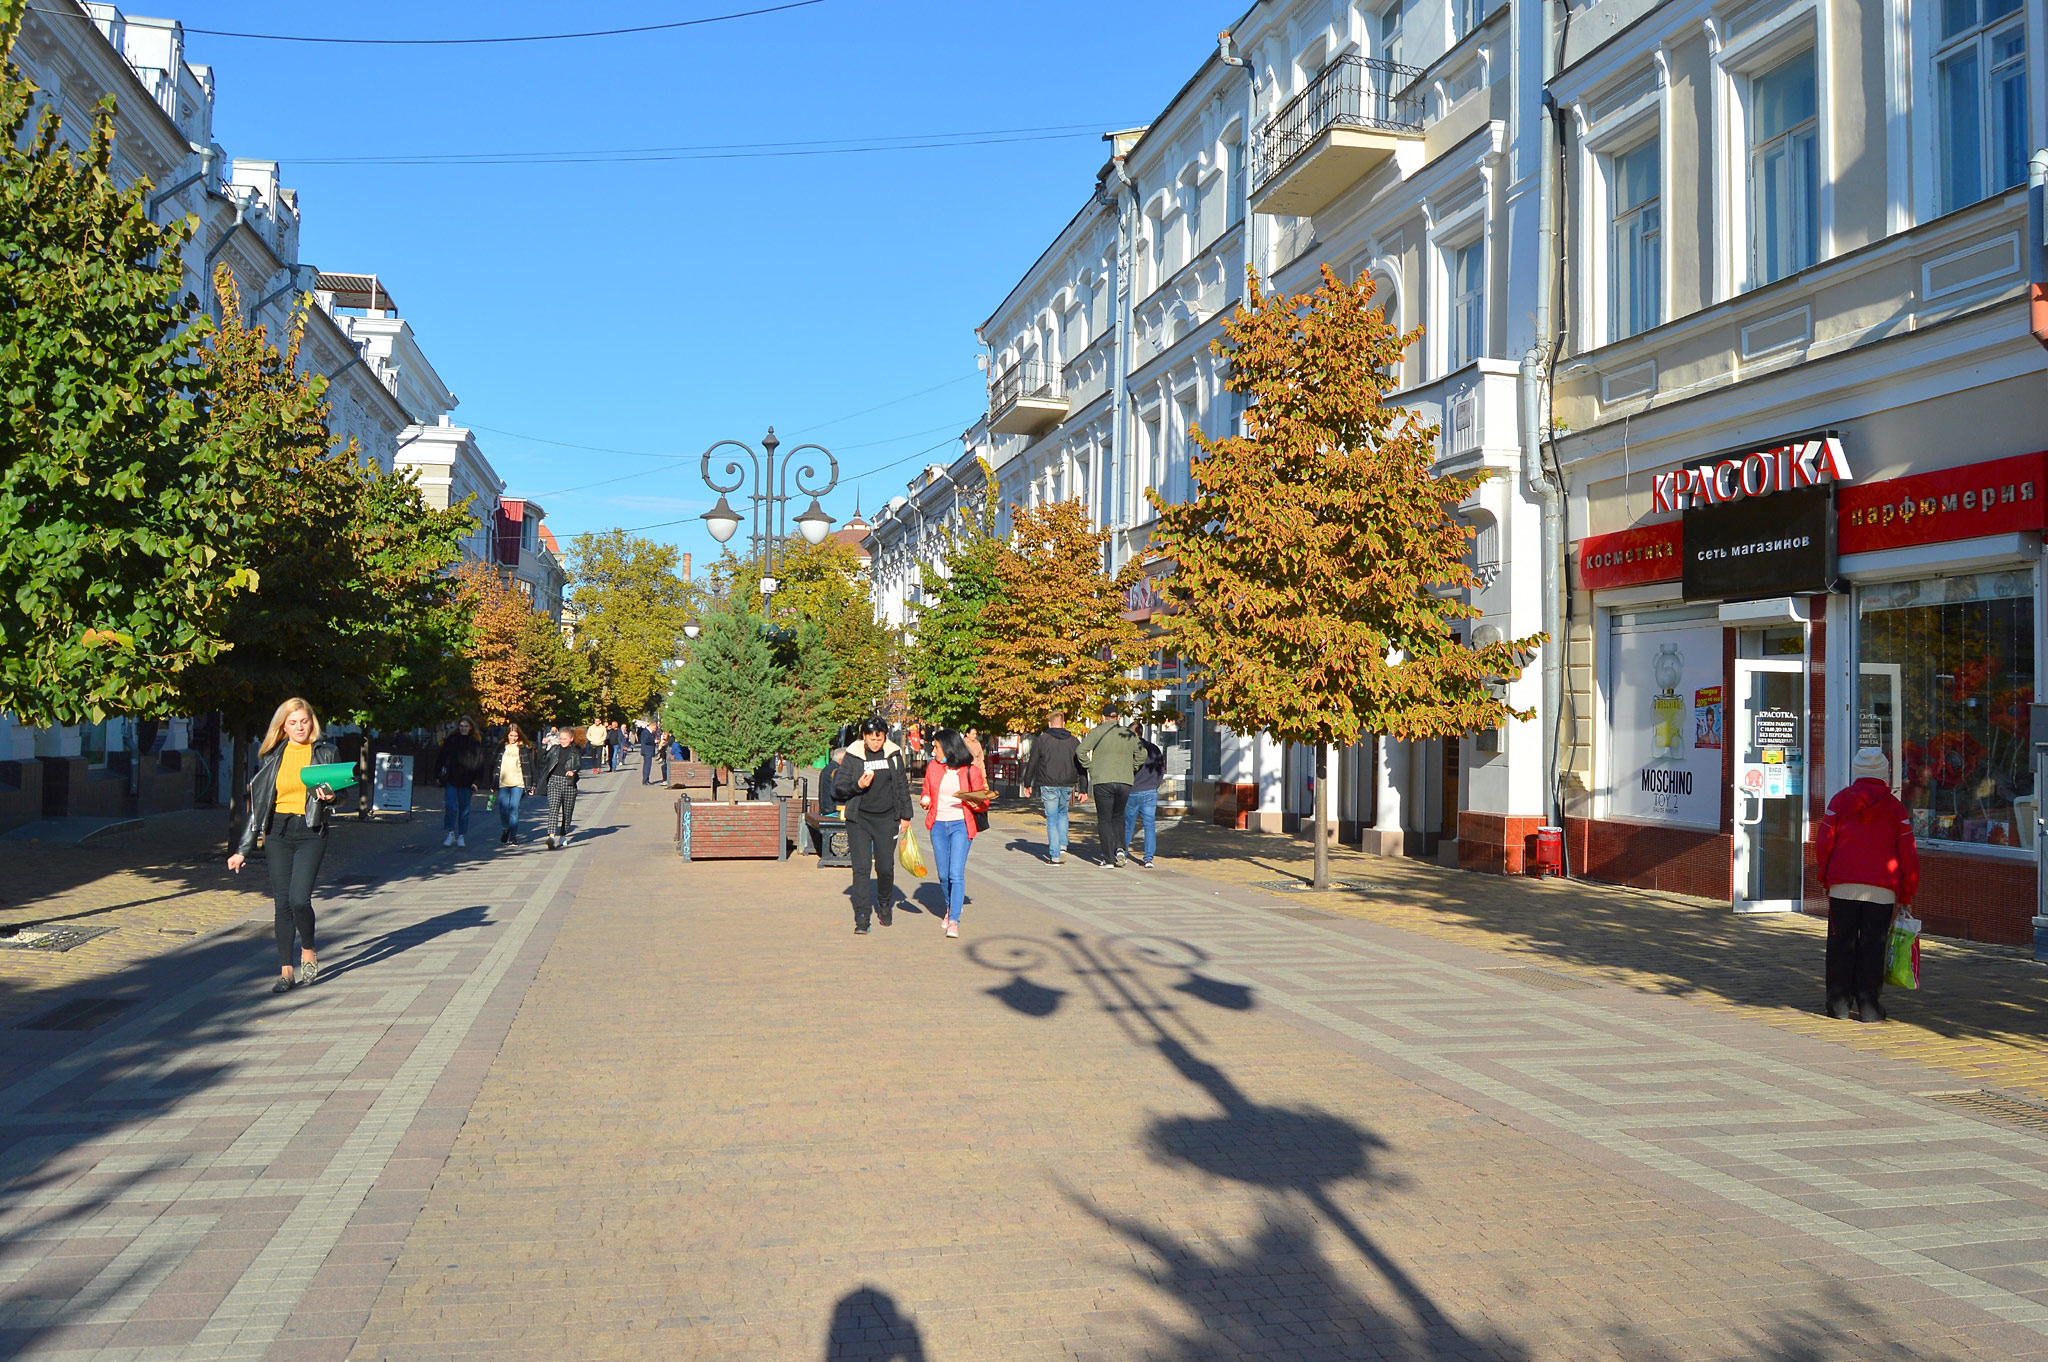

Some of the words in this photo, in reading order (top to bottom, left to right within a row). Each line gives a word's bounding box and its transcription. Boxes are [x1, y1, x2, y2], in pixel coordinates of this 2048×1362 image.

[1653, 438, 1852, 514] КРАСОТКА
[1851, 481, 2035, 527] парфюмерия
[1586, 541, 1674, 570] косметика
[1697, 549, 1727, 562] сеть
[1731, 535, 1810, 557] магазинов
[1759, 711, 1794, 719] КРАСОТКА
[1642, 769, 1692, 795] MOSCHINO
[1654, 793, 1670, 808] TOY
[1674, 794, 1678, 808] 2
